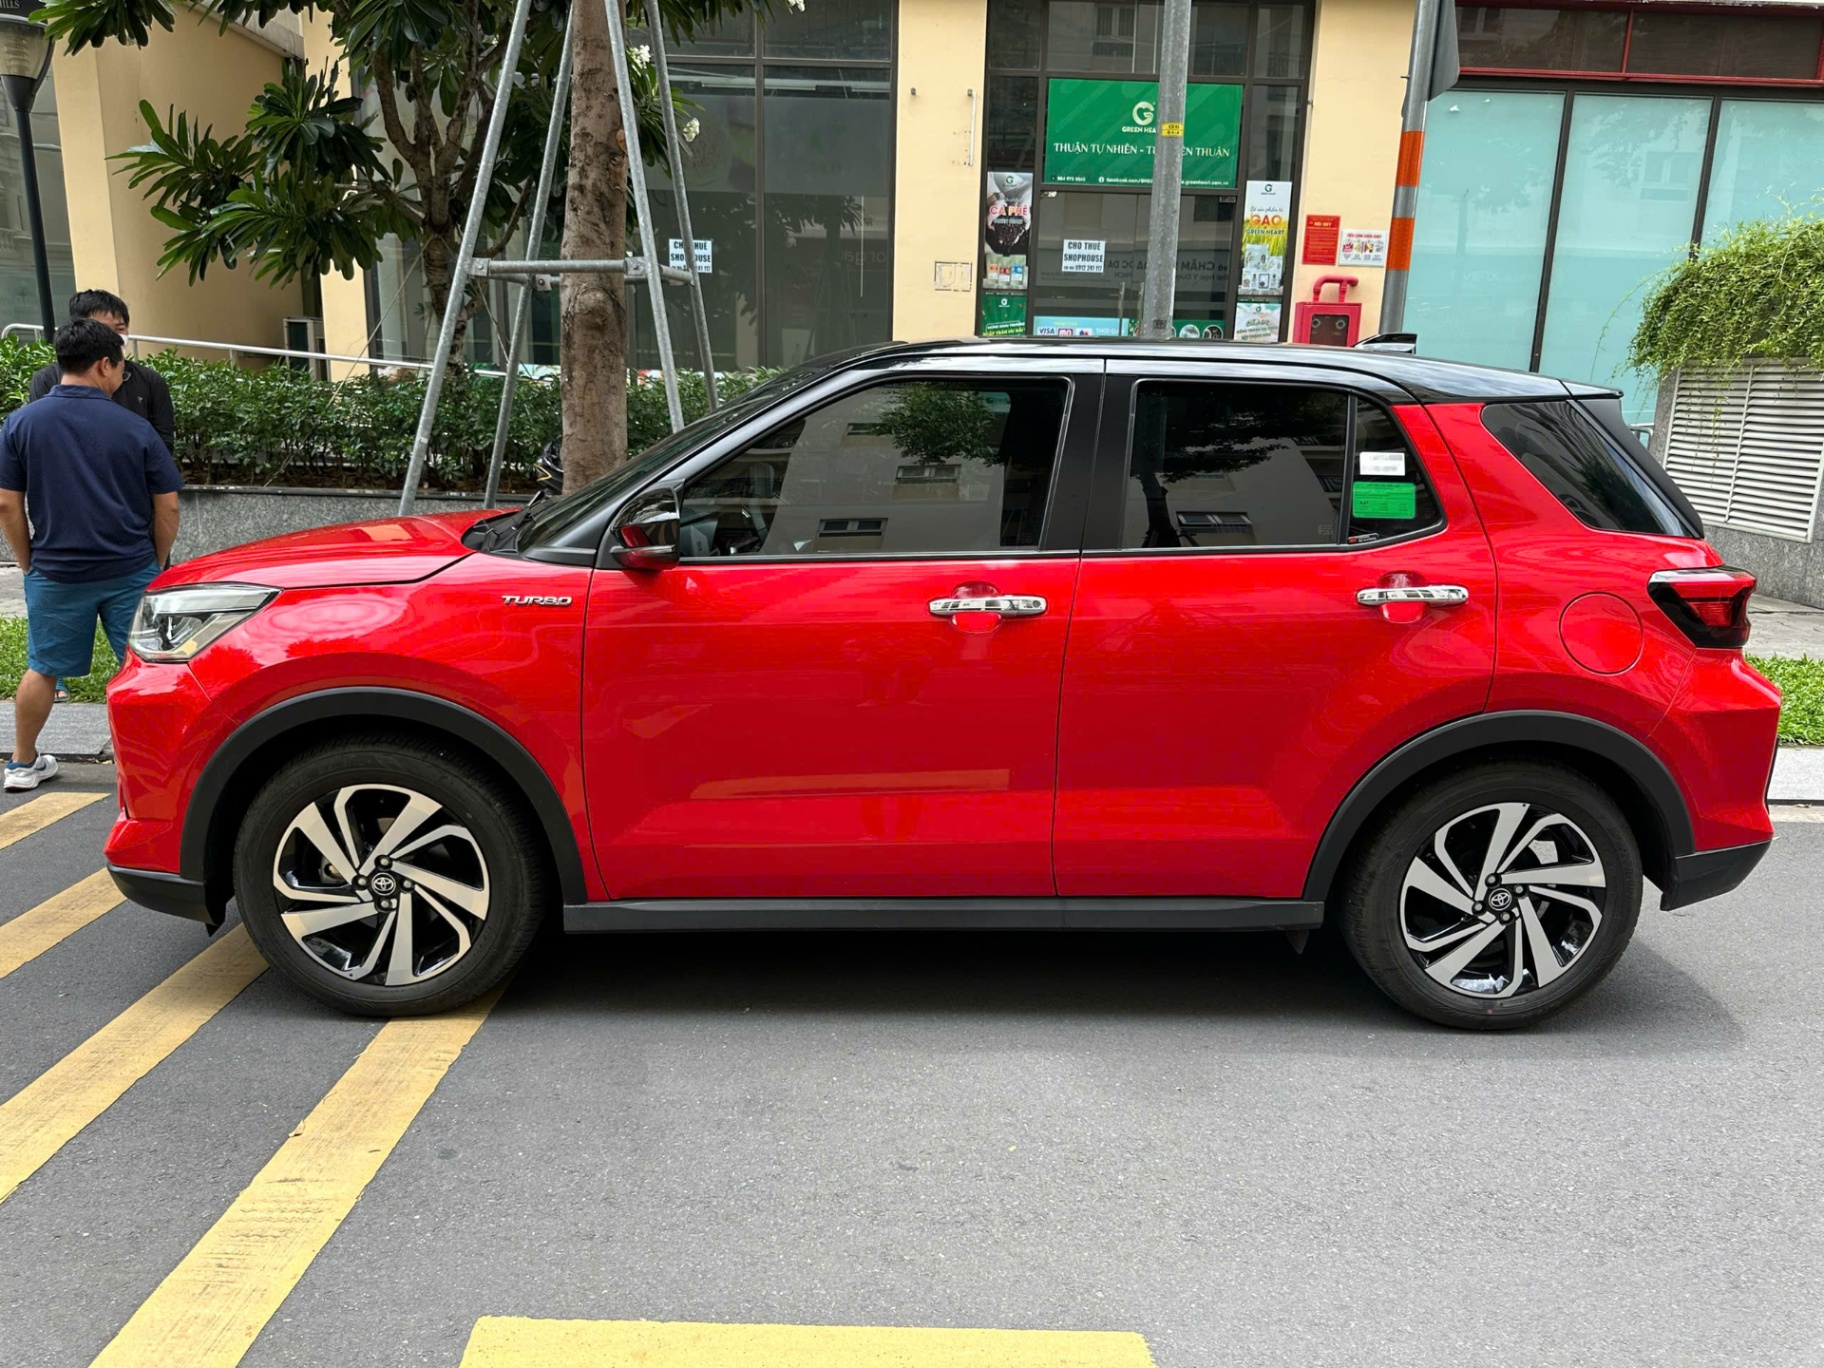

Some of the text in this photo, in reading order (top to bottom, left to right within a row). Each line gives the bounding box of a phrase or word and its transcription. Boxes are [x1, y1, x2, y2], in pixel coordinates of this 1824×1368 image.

[1053, 142, 1088, 155] THUẬN
[1090, 144, 1105, 155] TỰ
[1106, 145, 1138, 155] NHIÊN
[1196, 148, 1230, 158] THUẬN
[1250, 214, 1282, 229] GẠO
[673, 241, 707, 250] CH HUÊ
[1067, 241, 1082, 250] CHO
[1063, 253, 1103, 262] SHOPHOUSE
[501, 595, 572, 606] TURBO
